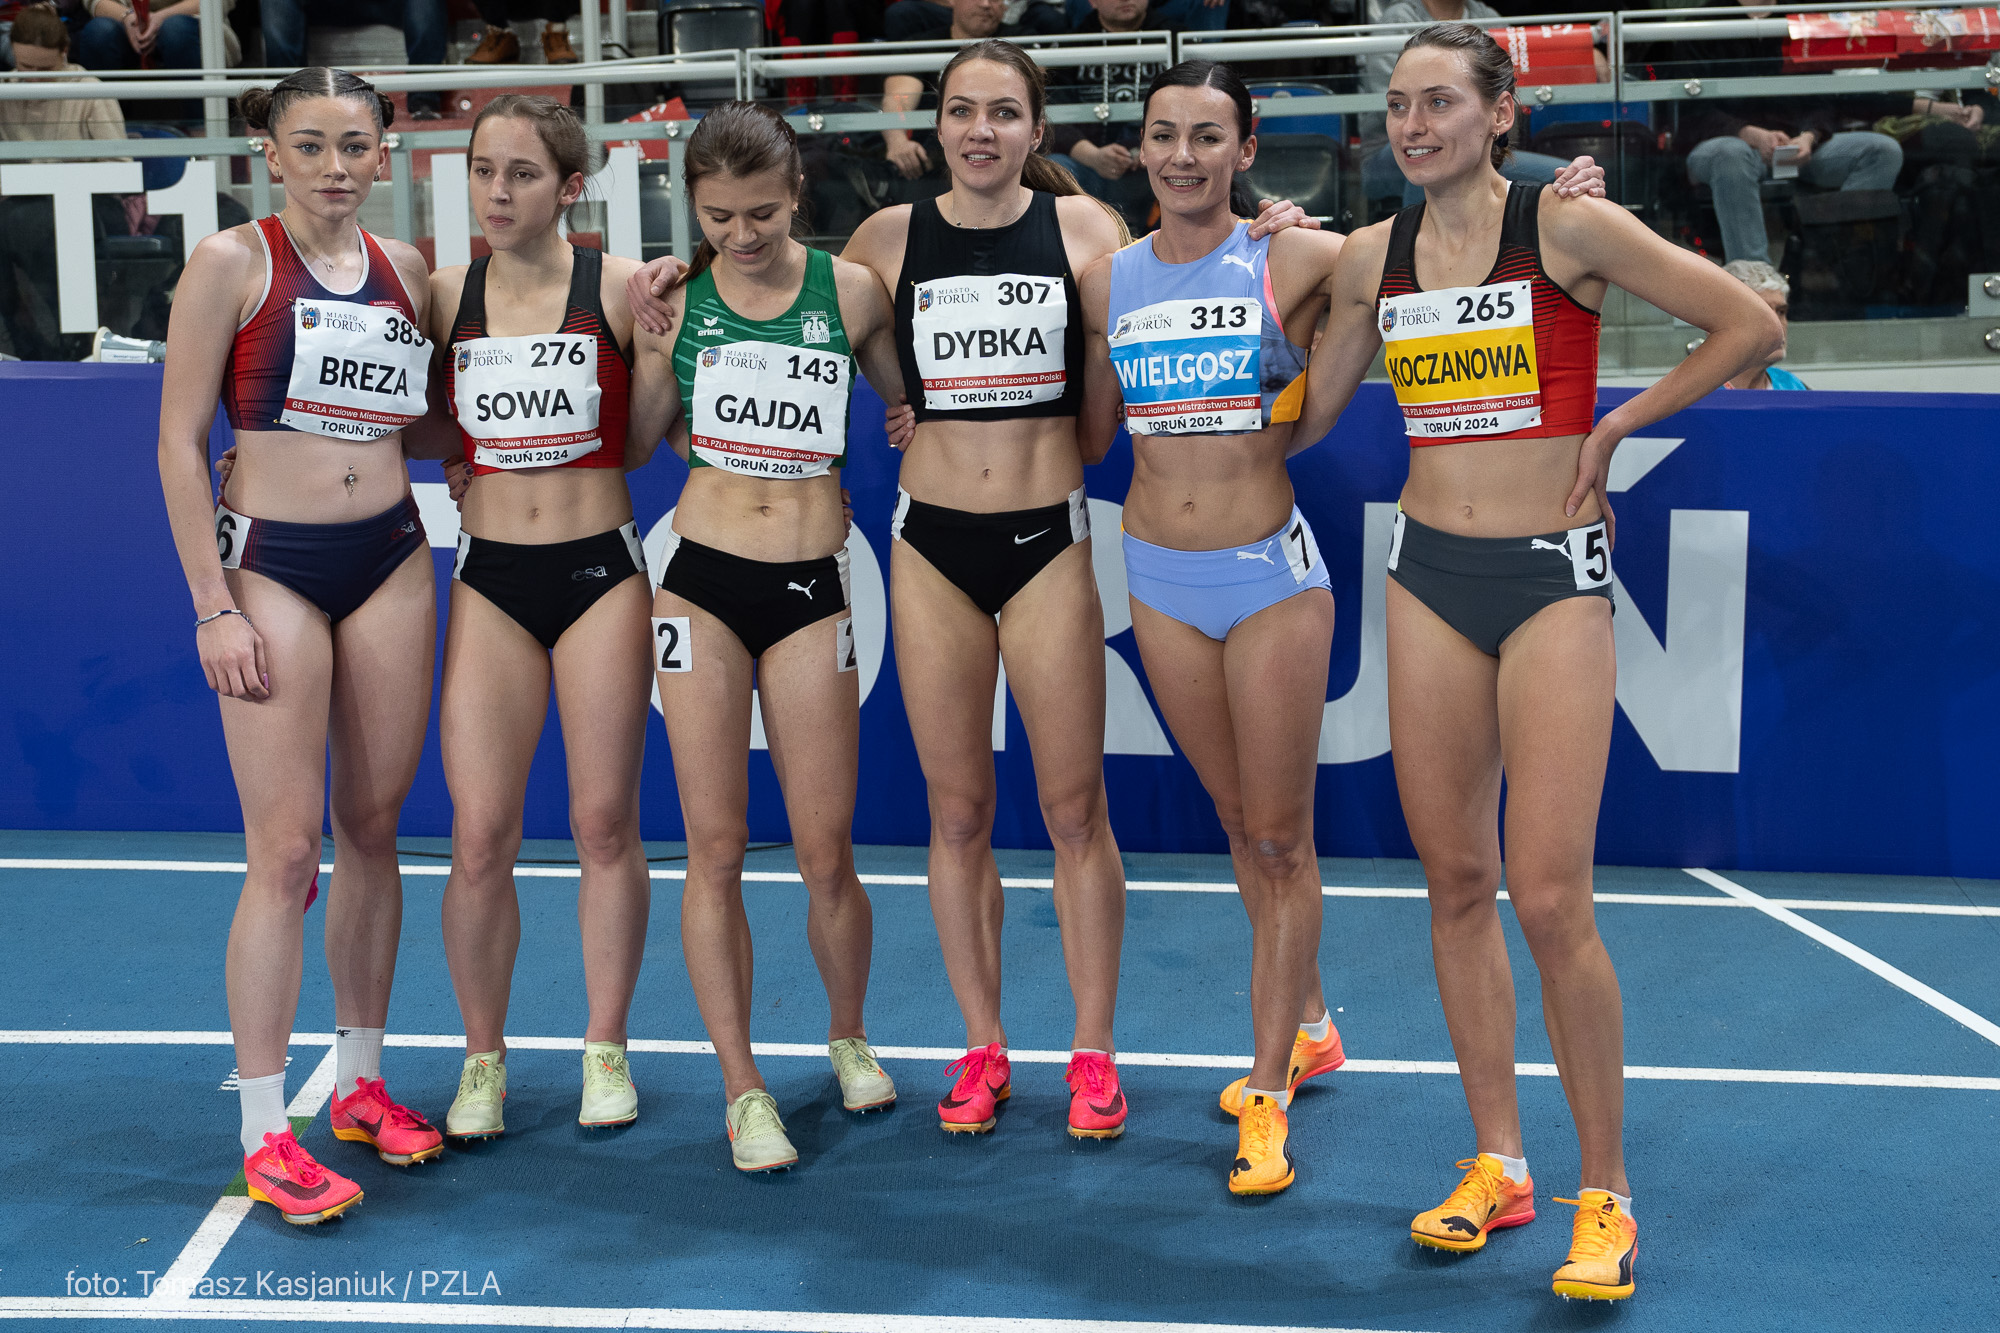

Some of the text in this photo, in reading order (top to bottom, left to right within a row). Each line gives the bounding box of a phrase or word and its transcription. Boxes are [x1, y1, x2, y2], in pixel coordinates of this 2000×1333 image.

[936, 290, 979, 305] TORUŃ
[938, 287, 970, 295] MIASTO
[997, 281, 1051, 306] 307
[326, 311, 358, 321] MIASTO
[1402, 305, 1431, 314] MIASTO
[1456, 291, 1515, 324] 265
[324, 318, 367, 333] TORUŃ
[1190, 305, 1247, 330] 313
[1400, 308, 1440, 326] TORUŃ
[697, 328, 724, 337] erima
[933, 327, 1047, 360] DYBKA
[473, 352, 513, 367] TORUŃ
[530, 341, 586, 367] 276
[726, 350, 759, 359] MIASTO
[723, 356, 768, 371] TORUŃ
[787, 354, 839, 385] 143
[1114, 350, 1253, 389] WIELGOSZ
[1389, 343, 1531, 387] KOCZANOWA
[319, 355, 409, 397] BREZA
[935, 379, 953, 388] PZLA
[954, 378, 987, 387] Halowe
[988, 375, 1038, 386] Mistrzostwa
[1039, 372, 1062, 382] Polski
[476, 388, 574, 422] SOWA
[951, 389, 1033, 404] TORUŃ 2024
[1423, 405, 1451, 415] Halowe
[1452, 401, 1503, 413] Mistrzostwa
[1505, 396, 1534, 407] Polski
[291, 400, 305, 410] 68.
[306, 404, 327, 414] PZLA
[328, 407, 358, 418] Halowe
[359, 411, 402, 424] Mistrzostwa
[715, 394, 823, 435] GAJDA
[1148, 404, 1176, 415] Halowe
[1177, 401, 1228, 412] Mistrzostwa
[1229, 399, 1256, 408] Polski
[321, 420, 364, 436] TORUŃ
[1147, 416, 1223, 431] TORUŃ 2024
[1423, 417, 1499, 433] TORUŃ 2024
[522, 436, 574, 447] Mistrzostwa
[574, 431, 597, 441] Polski
[697, 436, 709, 446] 68.
[710, 440, 728, 450] PZLA
[729, 443, 760, 454] Halowe
[761, 447, 811, 460] Mistrzostwa
[535, 449, 568, 462] 2024
[723, 456, 803, 474] TORUŃ 2024
[217, 514, 237, 562] 6
[1290, 520, 1311, 572] 7
[1586, 528, 1607, 582] 5
[657, 622, 682, 670] 2
